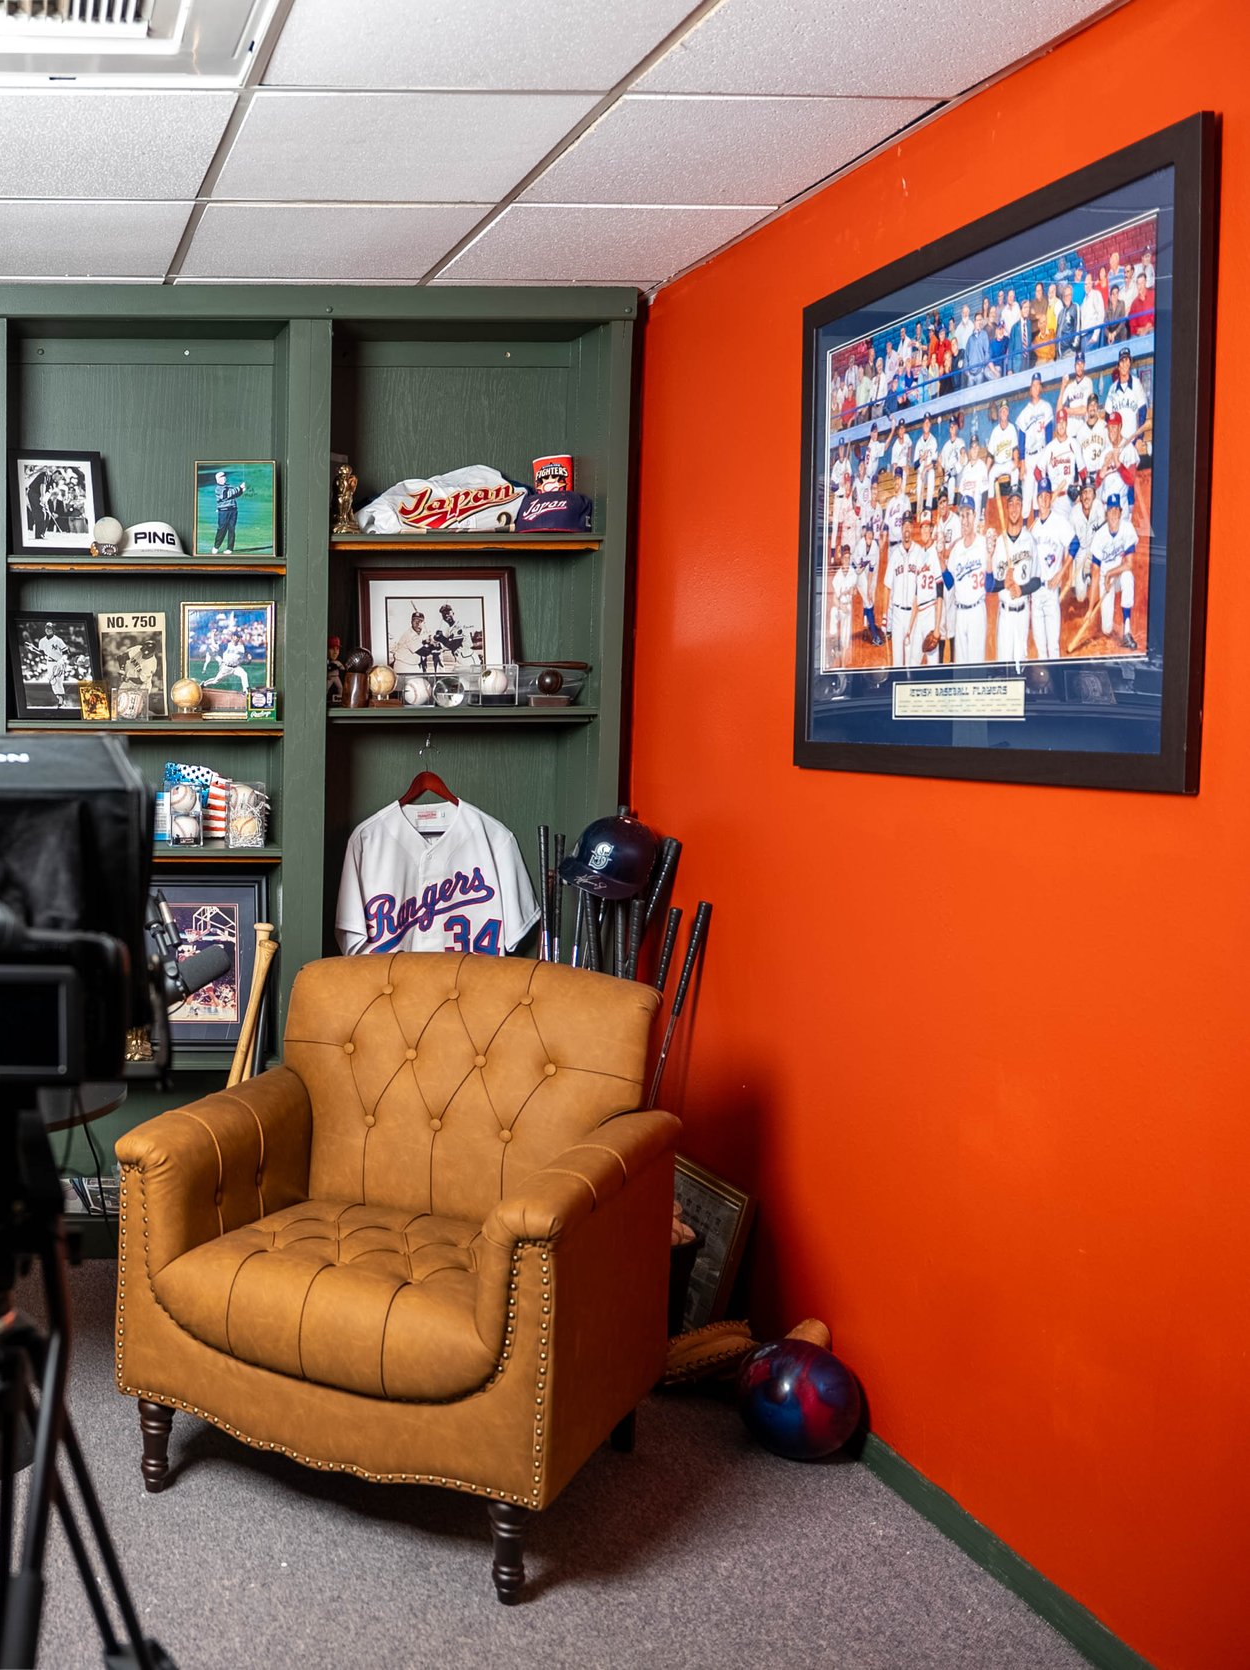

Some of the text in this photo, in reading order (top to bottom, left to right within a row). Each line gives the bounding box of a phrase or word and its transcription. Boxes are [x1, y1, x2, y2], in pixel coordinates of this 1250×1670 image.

[536, 466, 569, 480] FIGHTERS
[398, 484, 519, 524] Japan
[523, 499, 567, 519] Japan
[134, 532, 176, 546] PING
[1021, 564, 1028, 579] 8
[921, 575, 934, 590] 32
[972, 572, 985, 590] 32
[107, 615, 156, 628] NO. 750
[364, 867, 495, 944] Rangers
[443, 914, 502, 956] 34
